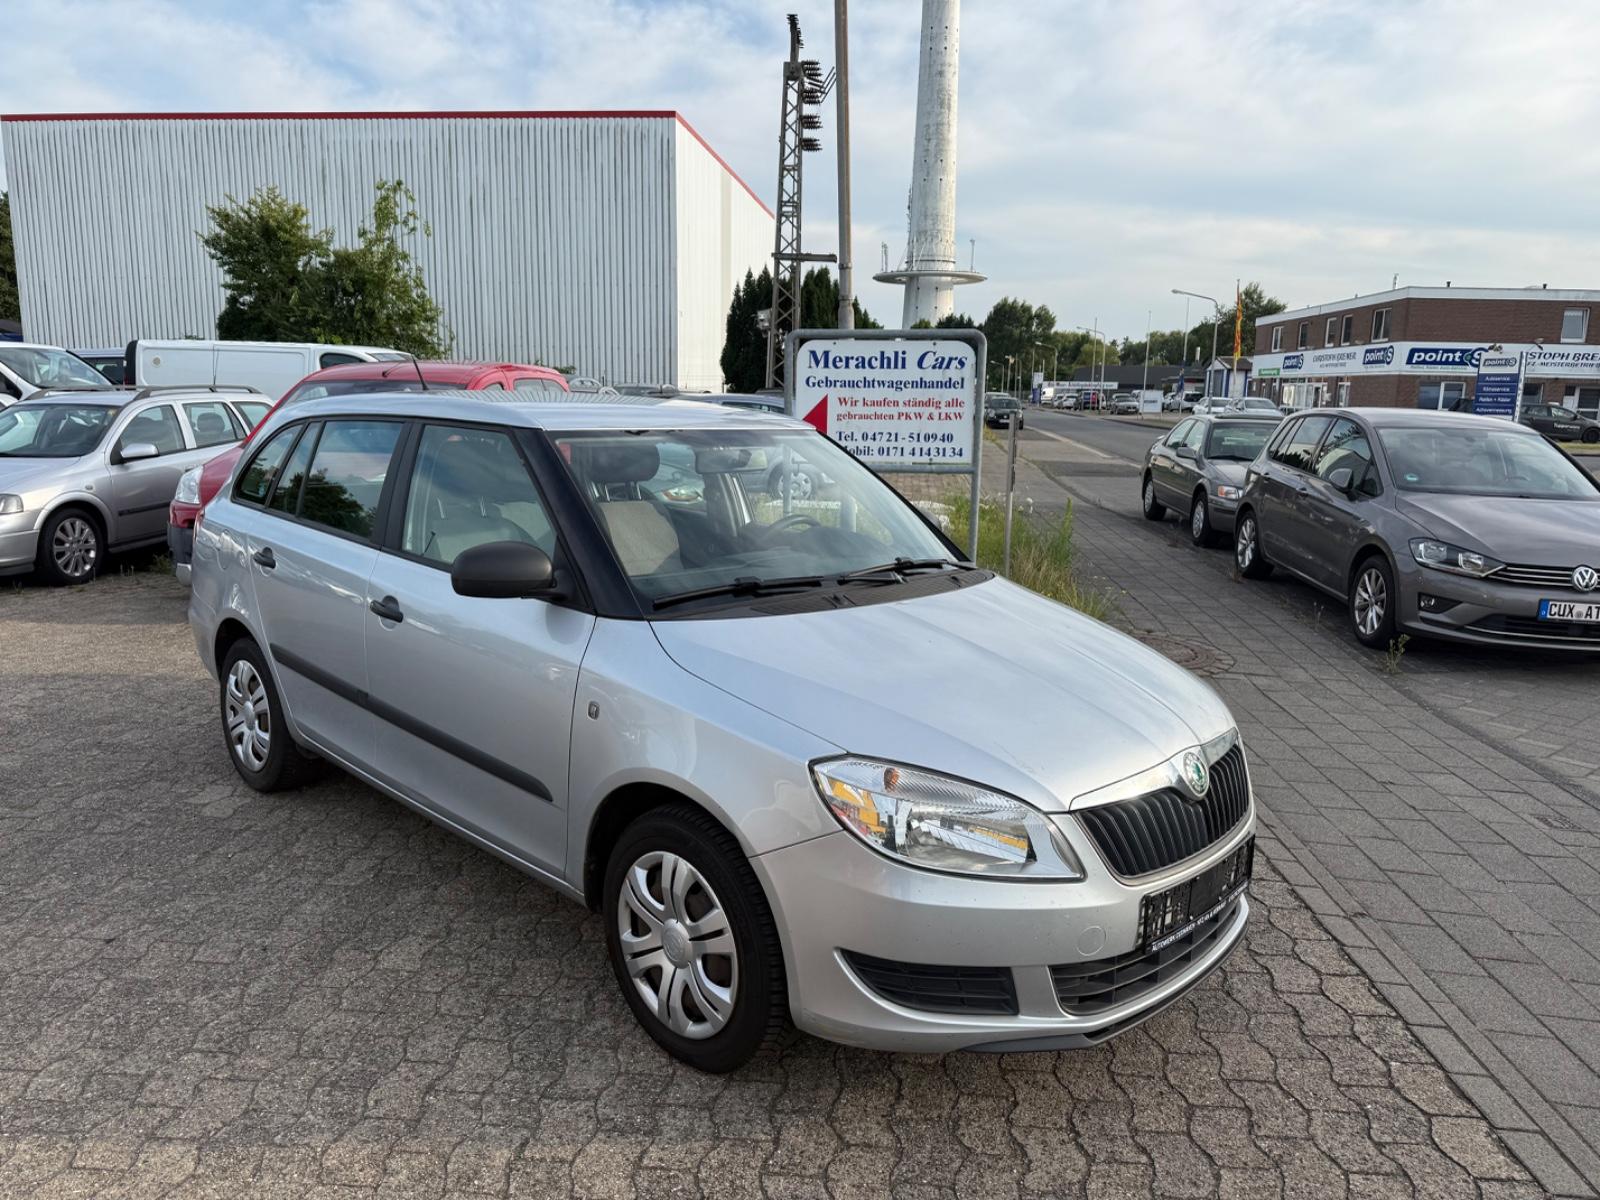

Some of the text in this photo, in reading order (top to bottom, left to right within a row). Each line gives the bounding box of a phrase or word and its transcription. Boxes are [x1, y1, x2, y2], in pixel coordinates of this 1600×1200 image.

[808, 350, 968, 370] Merachli Cars
[1365, 348, 1384, 362] point
[1412, 350, 1462, 363] point
[1527, 352, 1600, 362] STOPH BRE
[805, 375, 965, 391] Gebrauchtwagenhandel
[837, 397, 965, 409] Wir kaufen ständig alle
[836, 411, 964, 422] gebrauchten PKW & LKW
[836, 431, 858, 442] Tel.
[877, 447, 905, 457] 0171
[908, 447, 964, 457] 4143134
[1549, 604, 1575, 618] CUX
